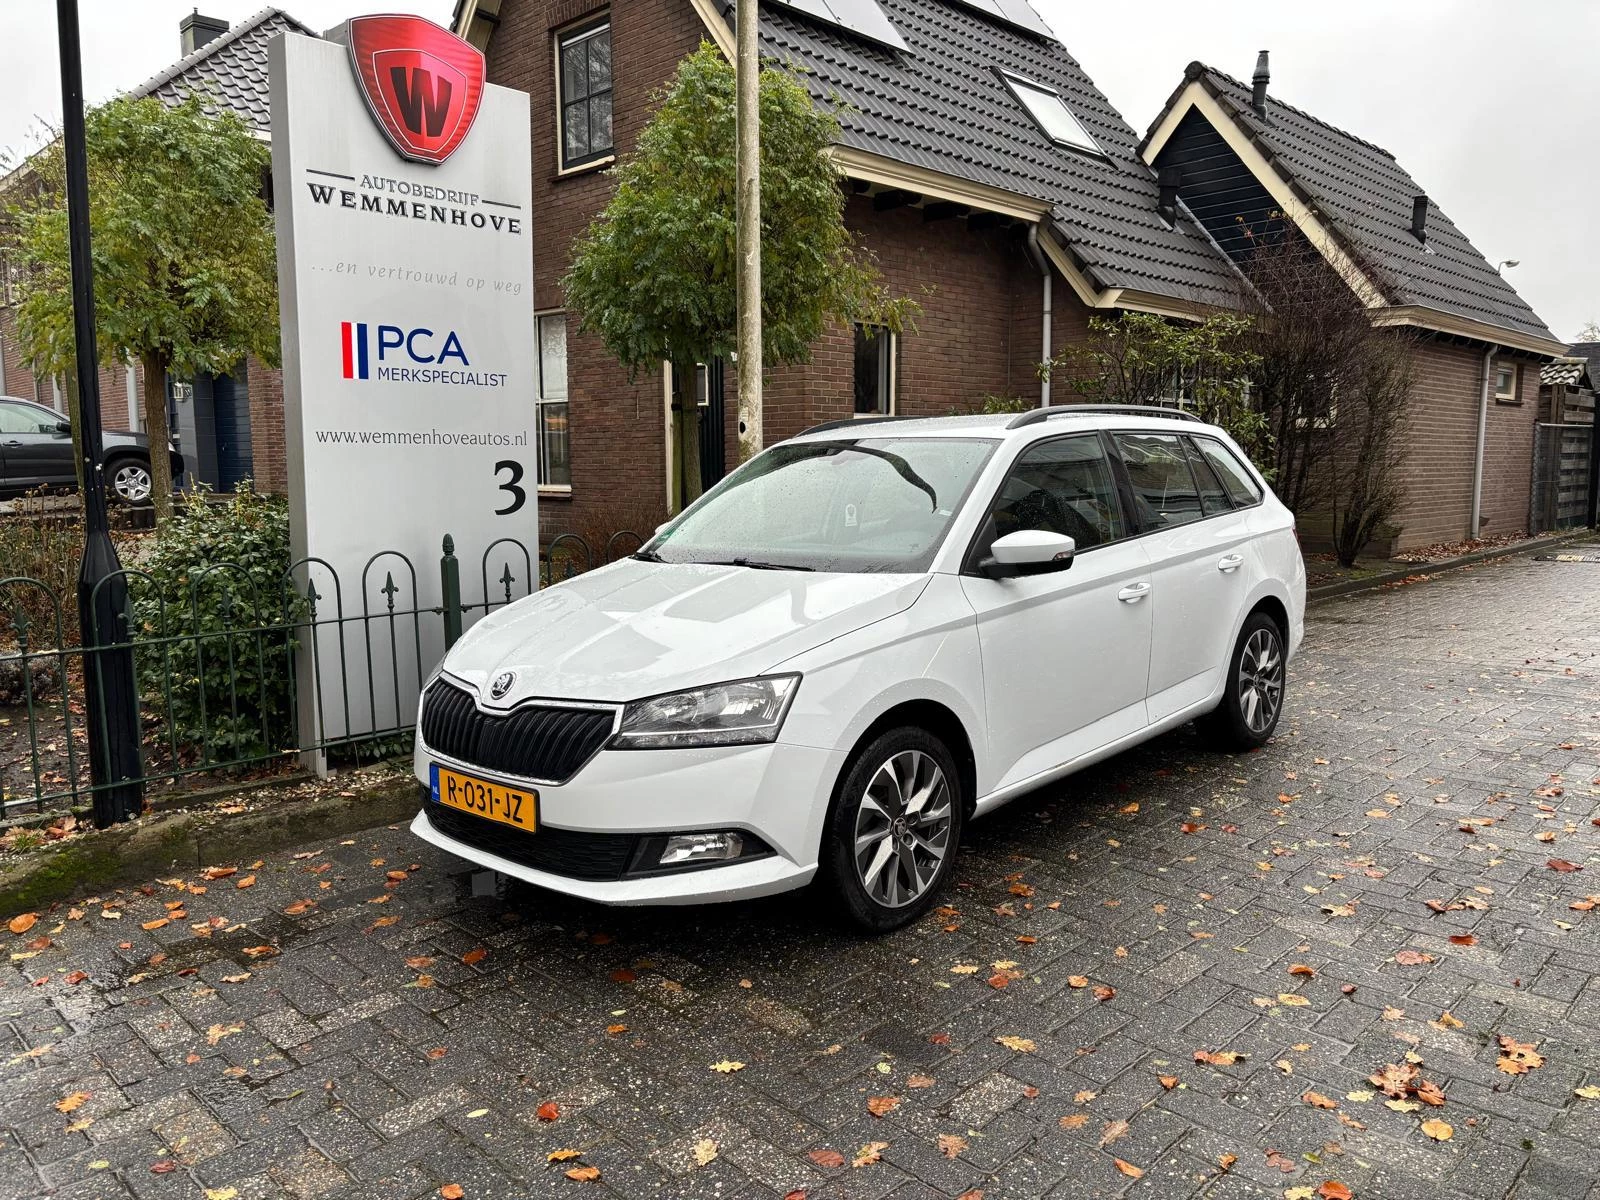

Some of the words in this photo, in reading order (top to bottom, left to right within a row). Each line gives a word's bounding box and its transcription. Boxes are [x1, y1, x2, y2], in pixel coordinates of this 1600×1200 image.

[390, 67, 453, 137] W
[306, 182, 521, 235] WEMMENHOVE
[360, 174, 480, 206] AUTOBEDRIJF
[368, 263, 457, 286] vertrouwd
[466, 274, 485, 290] op
[494, 280, 522, 296] weg
[377, 325, 470, 366] PCA
[377, 367, 508, 387] MERKSPECIALIST
[315, 429, 528, 447] www.wemmenhoveautos.nl
[494, 459, 526, 516] 3
[447, 775, 524, 824] R-031-JZ
